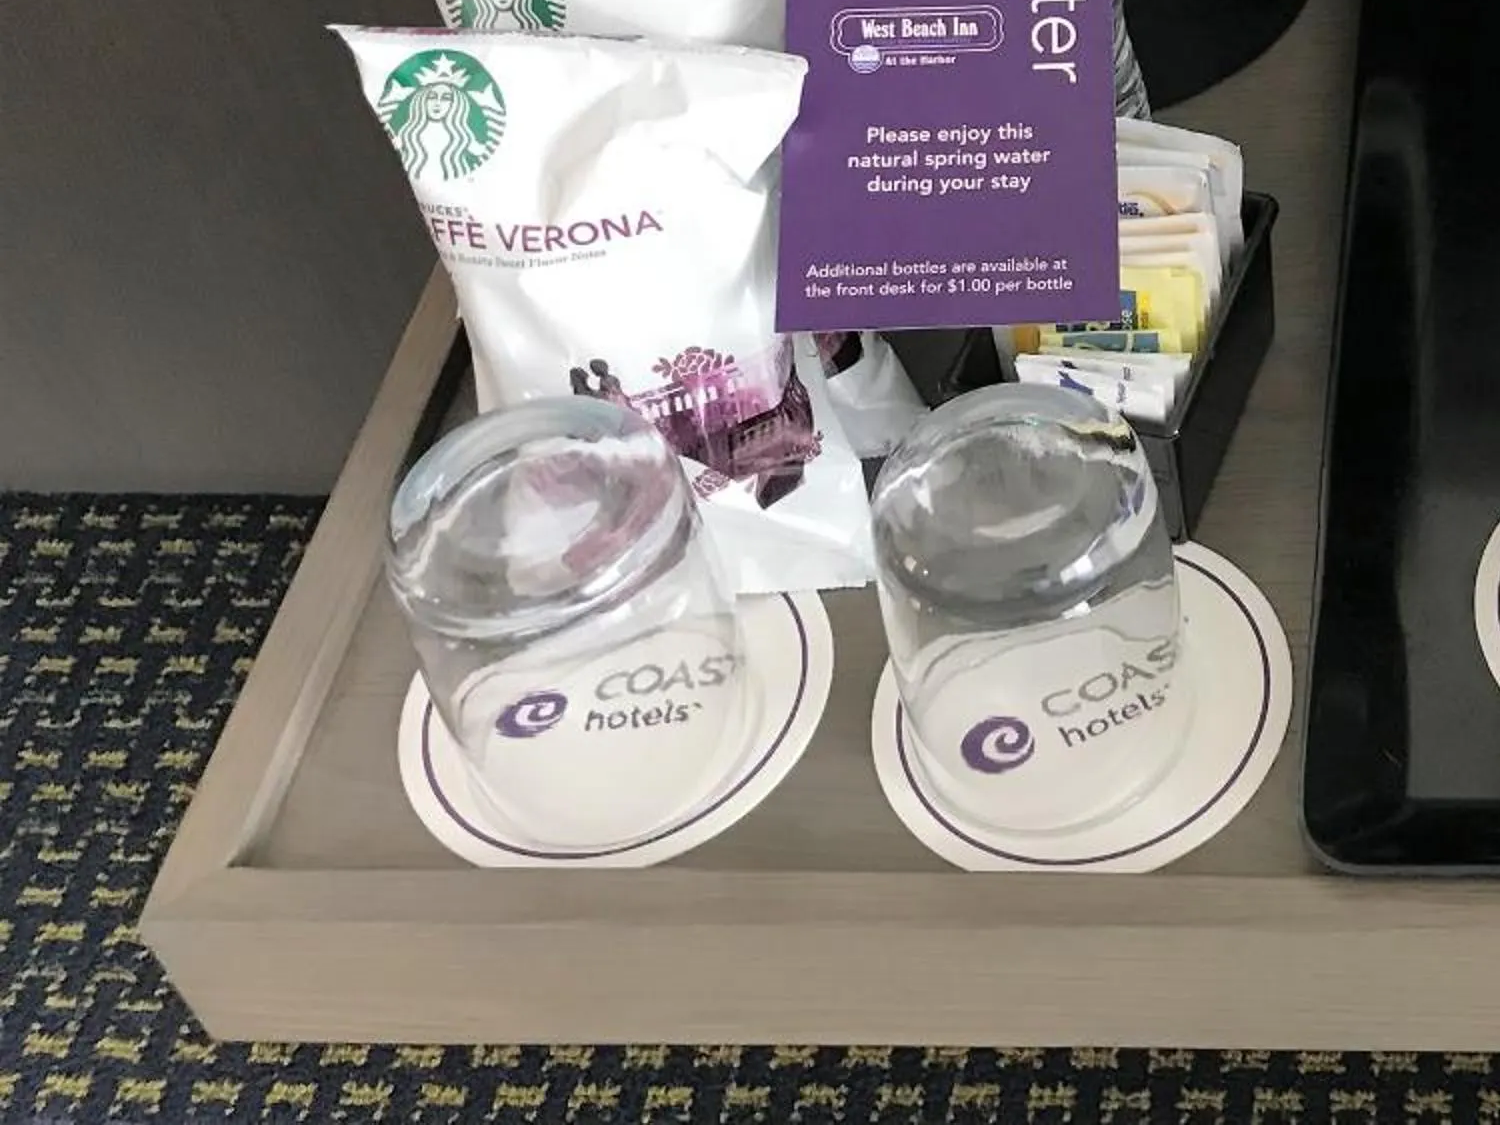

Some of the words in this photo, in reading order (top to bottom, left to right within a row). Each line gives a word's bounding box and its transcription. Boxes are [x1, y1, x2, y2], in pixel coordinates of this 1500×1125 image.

[861, 18, 896, 39] West
[901, 18, 947, 38] Beach
[953, 16, 979, 36] Inn
[900, 55, 917, 66] the
[920, 55, 957, 66] Harbor
[866, 126, 931, 144] Please
[937, 125, 992, 146] enjoy
[998, 122, 1034, 140] this
[847, 149, 919, 168] natural
[924, 149, 988, 170] spring
[993, 148, 1051, 164] water
[867, 175, 934, 196] during
[938, 176, 985, 194] your
[991, 174, 1032, 193] stay
[431, 214, 488, 250] FFÈ
[495, 210, 665, 253] VERONA
[805, 262, 888, 278] Additional
[893, 261, 947, 276] bottles
[951, 262, 976, 274] are
[980, 257, 1048, 273] available
[1053, 259, 1068, 272] at
[805, 283, 832, 297] the
[836, 281, 875, 297] front
[879, 280, 916, 296] desk
[920, 279, 943, 294] for
[947, 278, 991, 293] $1.00
[995, 279, 1022, 295] per
[1026, 275, 1073, 291] bottle
[1040, 640, 1177, 717] COAS
[584, 699, 690, 732] hotels
[1058, 688, 1166, 748] hotels
